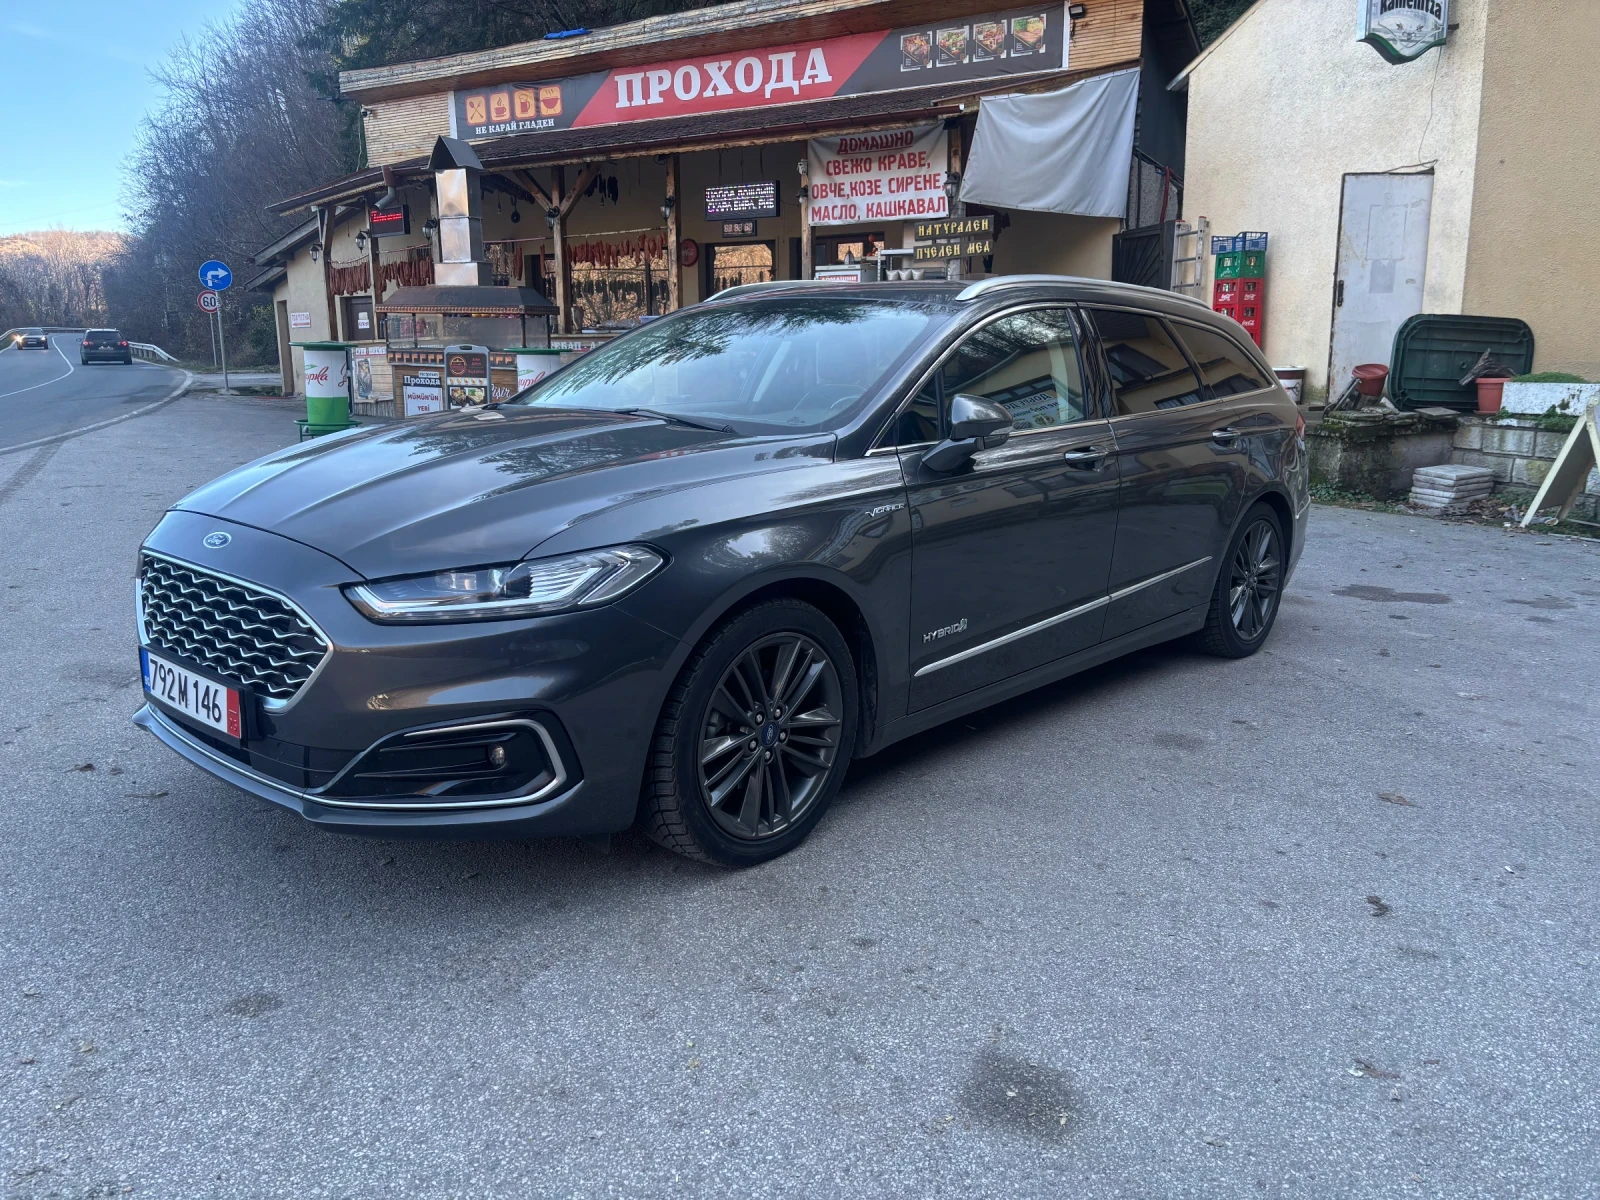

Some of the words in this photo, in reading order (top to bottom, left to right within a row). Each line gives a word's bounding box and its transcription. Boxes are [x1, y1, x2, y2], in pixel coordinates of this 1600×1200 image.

[614, 47, 832, 108] ПРОХОДА
[475, 126, 487, 135] НЕ
[488, 120, 517, 133] КАРАЙ
[519, 118, 555, 129] ГЛАДЕН
[837, 130, 914, 154] ДОМАШНО
[826, 156, 873, 177] СВЕЖО
[878, 151, 931, 171] КРАВЕ,
[888, 173, 946, 194] СИРЕНЕ,
[811, 204, 861, 221] МАСЛО,
[866, 196, 947, 218] КАШКАВАЛ
[918, 219, 989, 237] НАТУРАЛЕН
[916, 243, 961, 260] ПЧЕЛЕН
[203, 296, 217, 308] 60
[404, 376, 441, 386] Прохода
[922, 623, 961, 643] HYBRID
